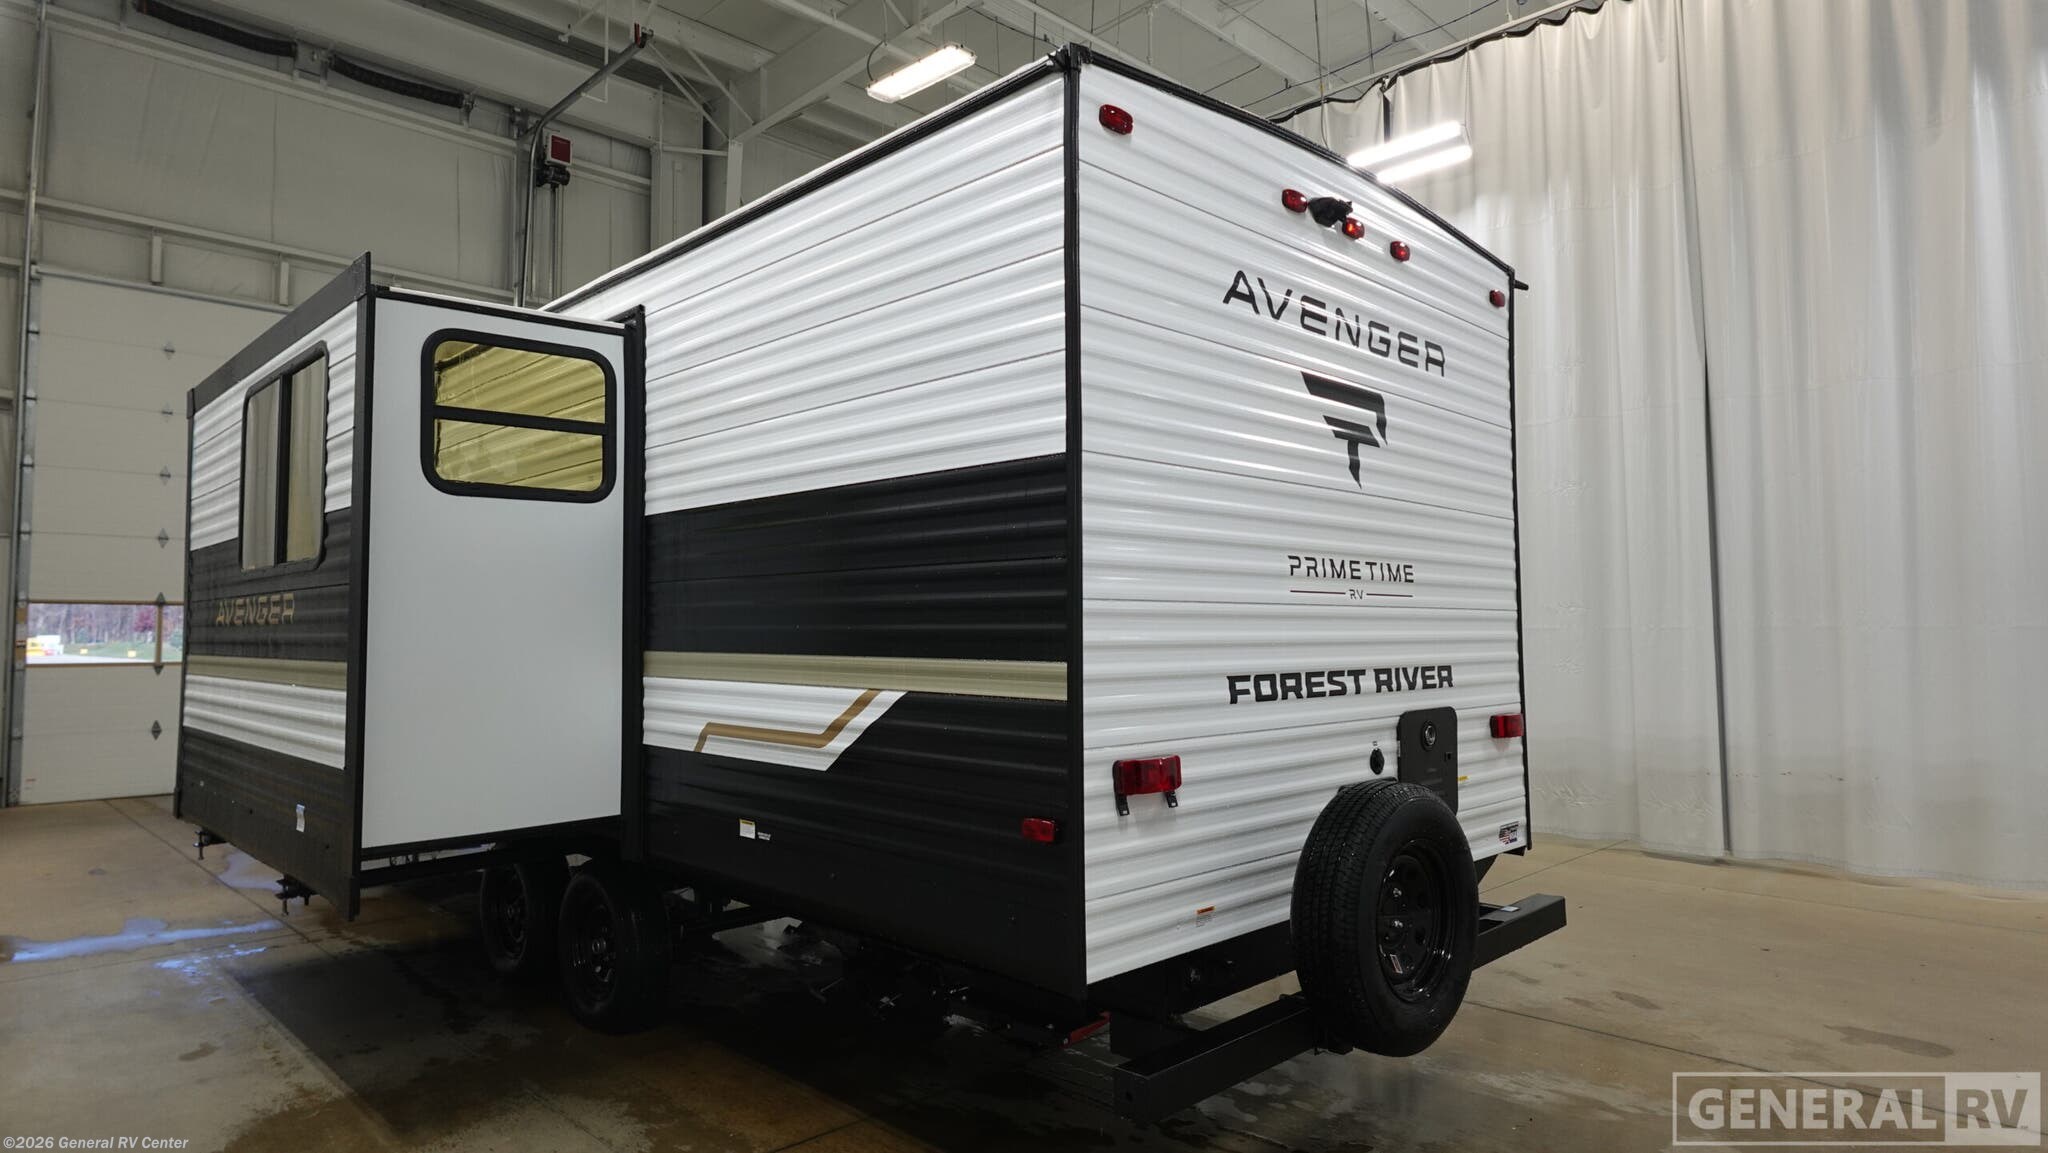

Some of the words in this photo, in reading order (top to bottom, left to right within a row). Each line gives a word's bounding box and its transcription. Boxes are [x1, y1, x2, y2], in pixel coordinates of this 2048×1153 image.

[1222, 269, 1446, 378] AVENGER
[1287, 555, 1415, 583] PRIMETIME
[215, 592, 295, 627] AVENGER
[1348, 589, 1364, 600] RV
[1226, 669, 1367, 705] FOREST
[1373, 665, 1454, 693] RIVER
